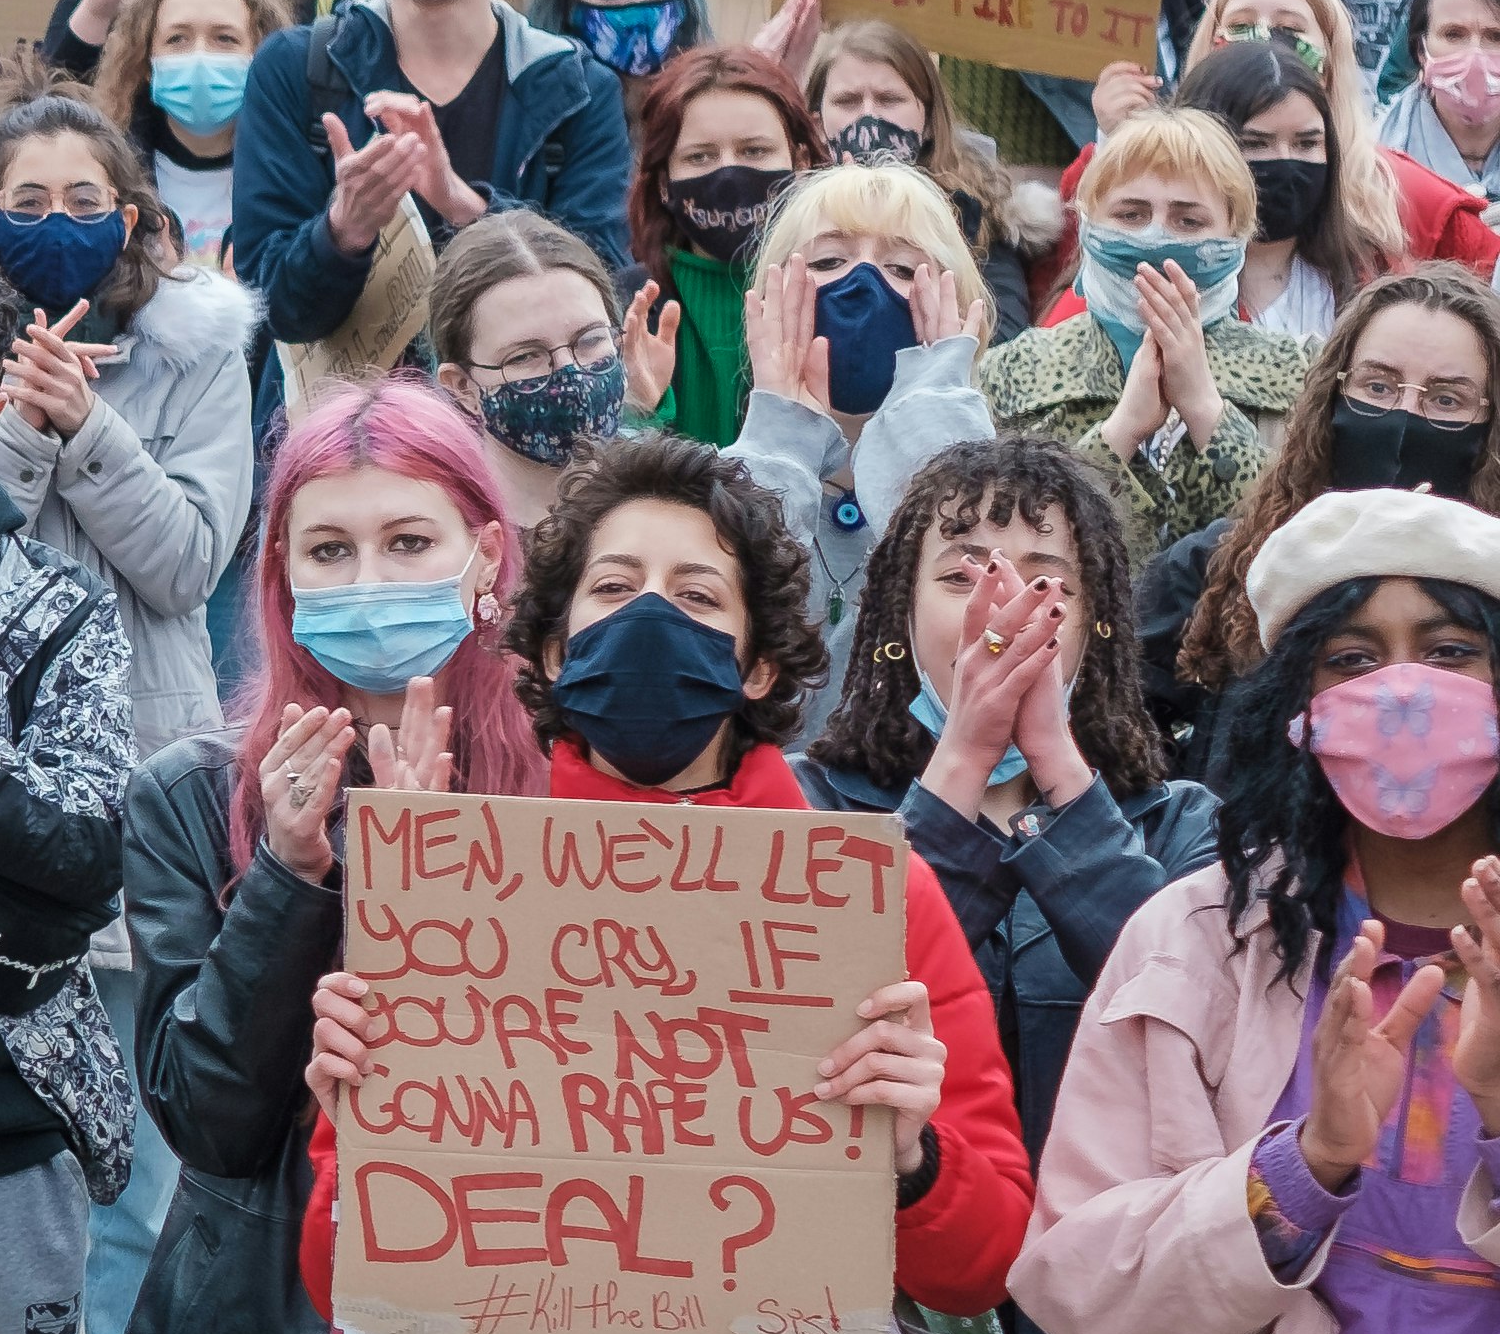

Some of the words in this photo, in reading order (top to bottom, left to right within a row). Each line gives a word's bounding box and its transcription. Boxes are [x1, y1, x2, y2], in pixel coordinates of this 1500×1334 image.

[1100, 6, 1154, 49] IT
[357, 801, 526, 902] MEN,
[761, 825, 895, 915] LET
[355, 898, 509, 981] YOU
[551, 917, 698, 996] CRY,
[739, 919, 822, 991] IF
[613, 1006, 770, 1088] NOT
[349, 1064, 542, 1150] GONNA
[560, 1071, 717, 1156] RAPE
